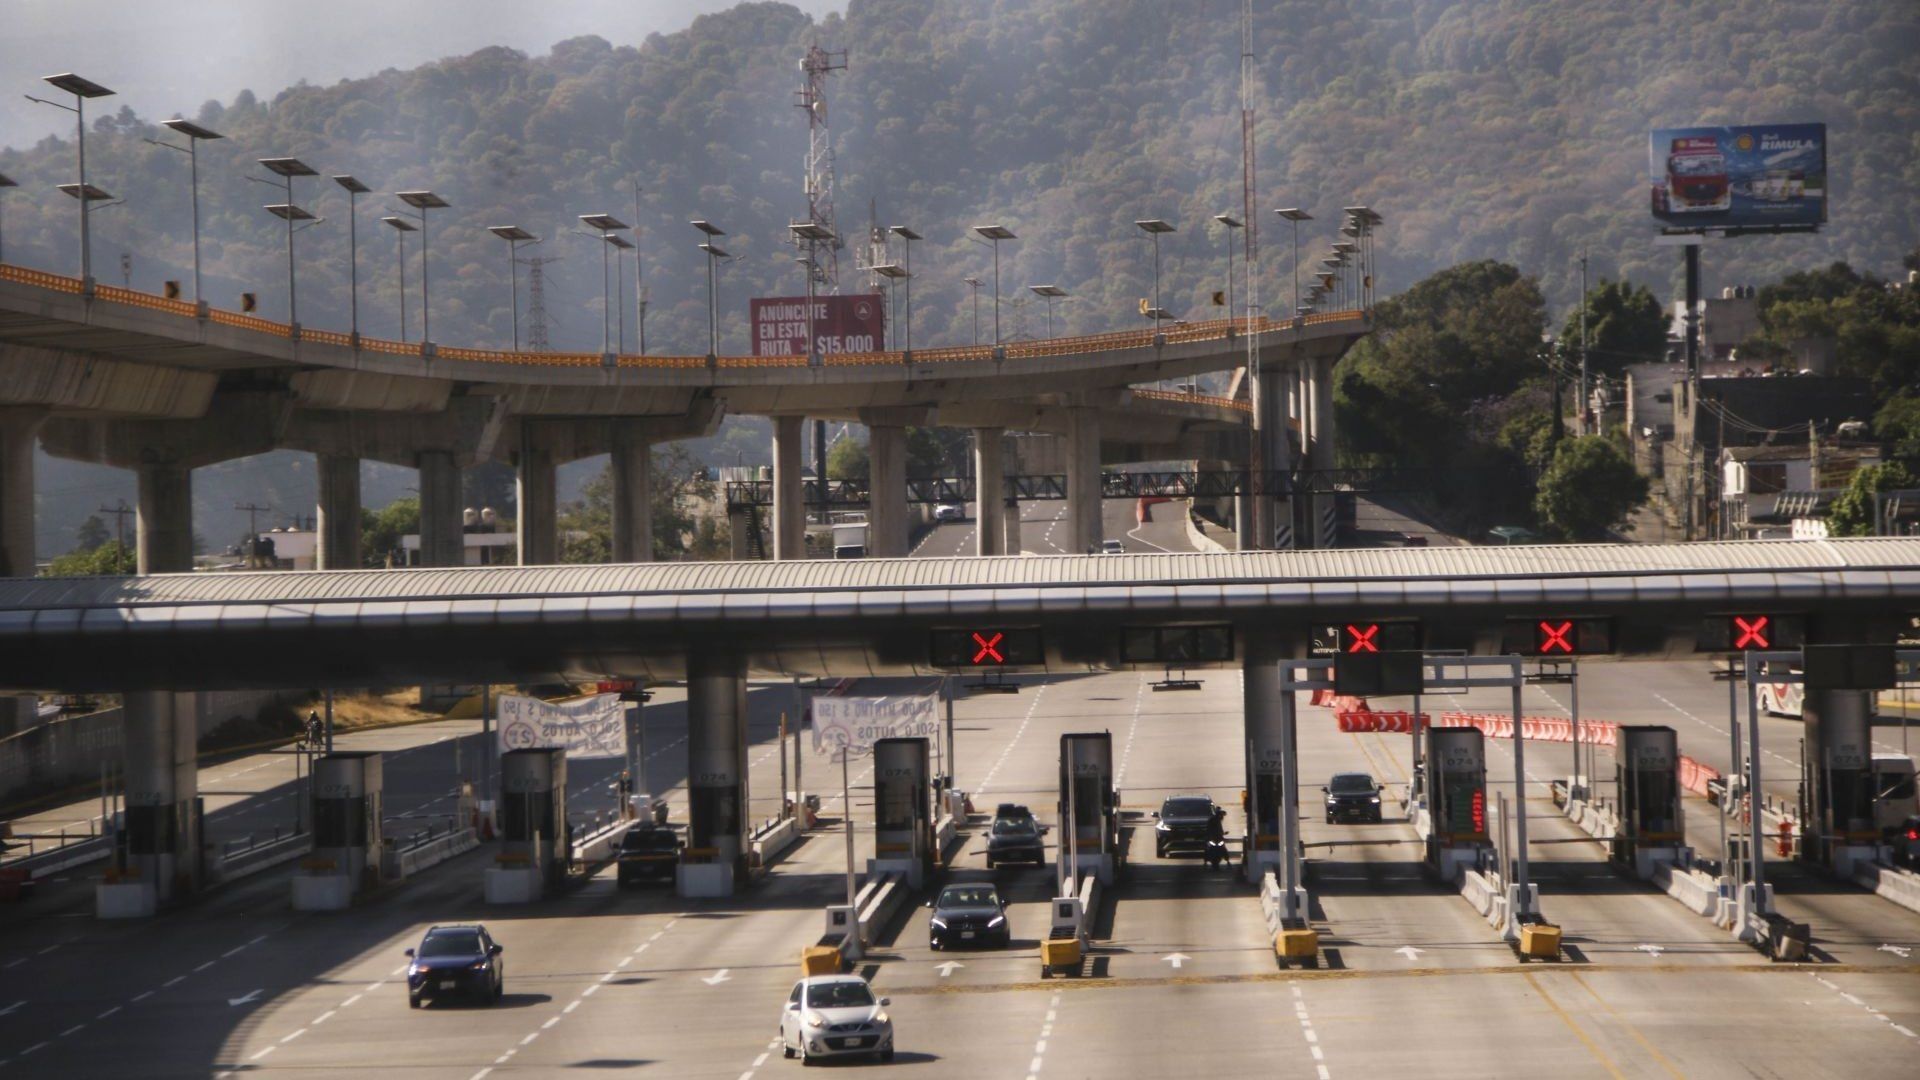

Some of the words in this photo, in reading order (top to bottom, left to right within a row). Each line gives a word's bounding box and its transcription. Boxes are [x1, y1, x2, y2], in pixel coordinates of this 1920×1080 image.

[1761, 139, 1815, 151] RIMULA
[760, 323, 775, 340] EN
[778, 322, 808, 338] ESTA
[760, 340, 792, 356] RUTA
[1446, 758, 1473, 767] 074
